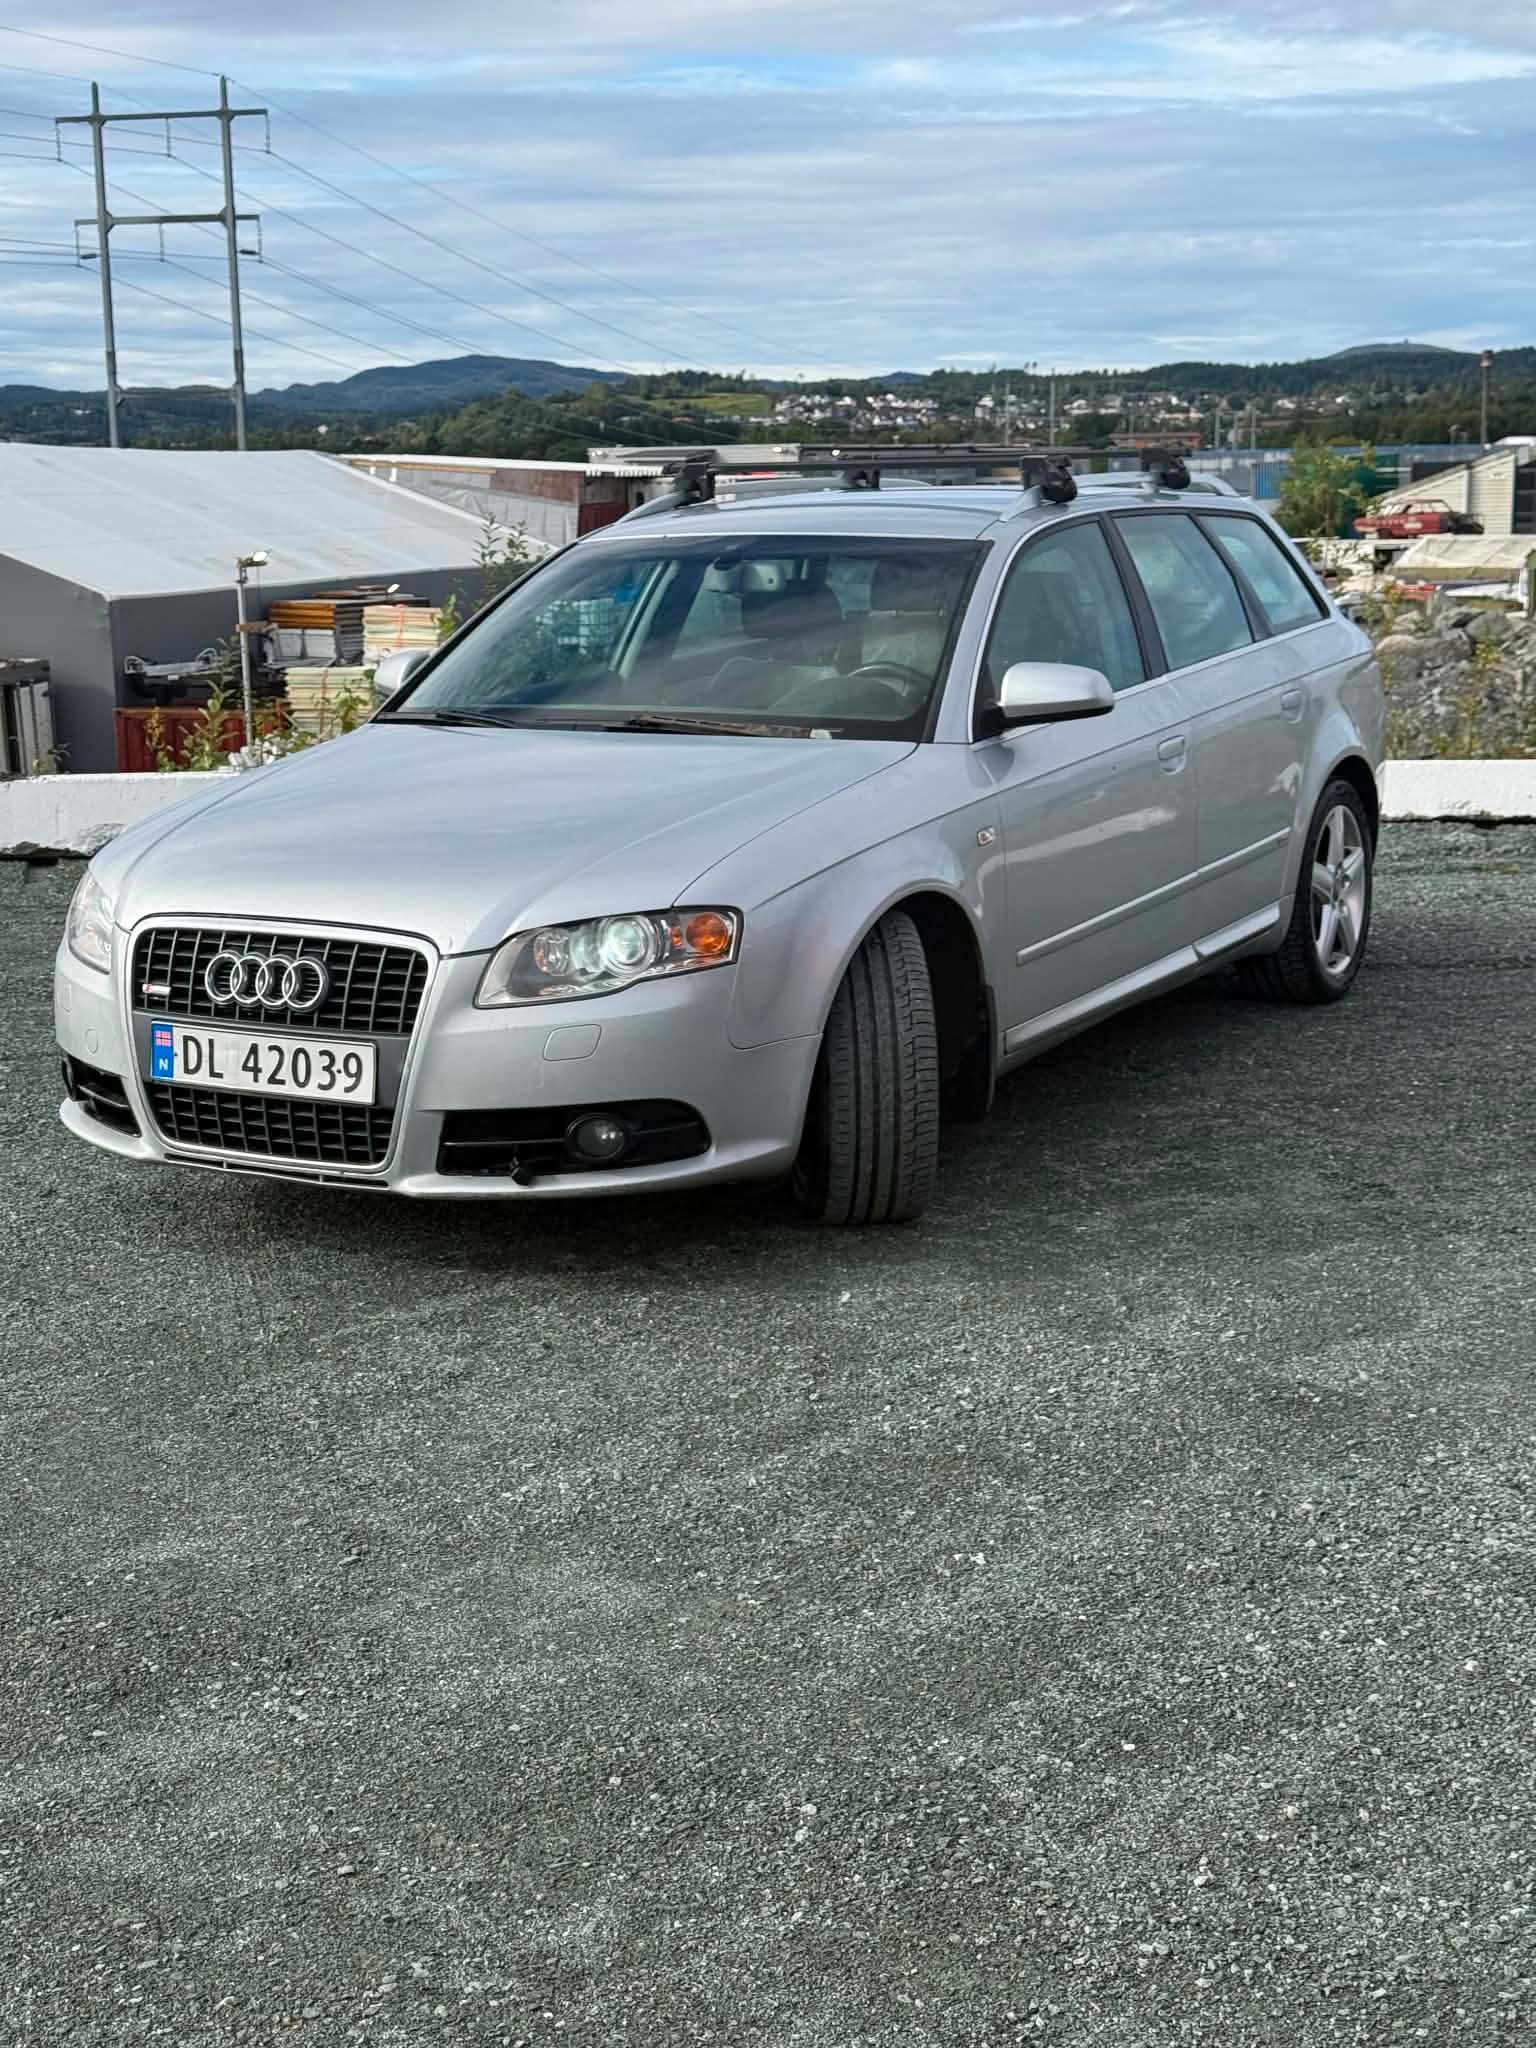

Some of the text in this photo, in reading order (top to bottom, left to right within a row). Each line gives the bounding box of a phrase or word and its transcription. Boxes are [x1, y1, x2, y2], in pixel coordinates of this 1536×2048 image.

[159, 1059, 168, 1071] N
[182, 1035, 363, 1093] DL 42039
